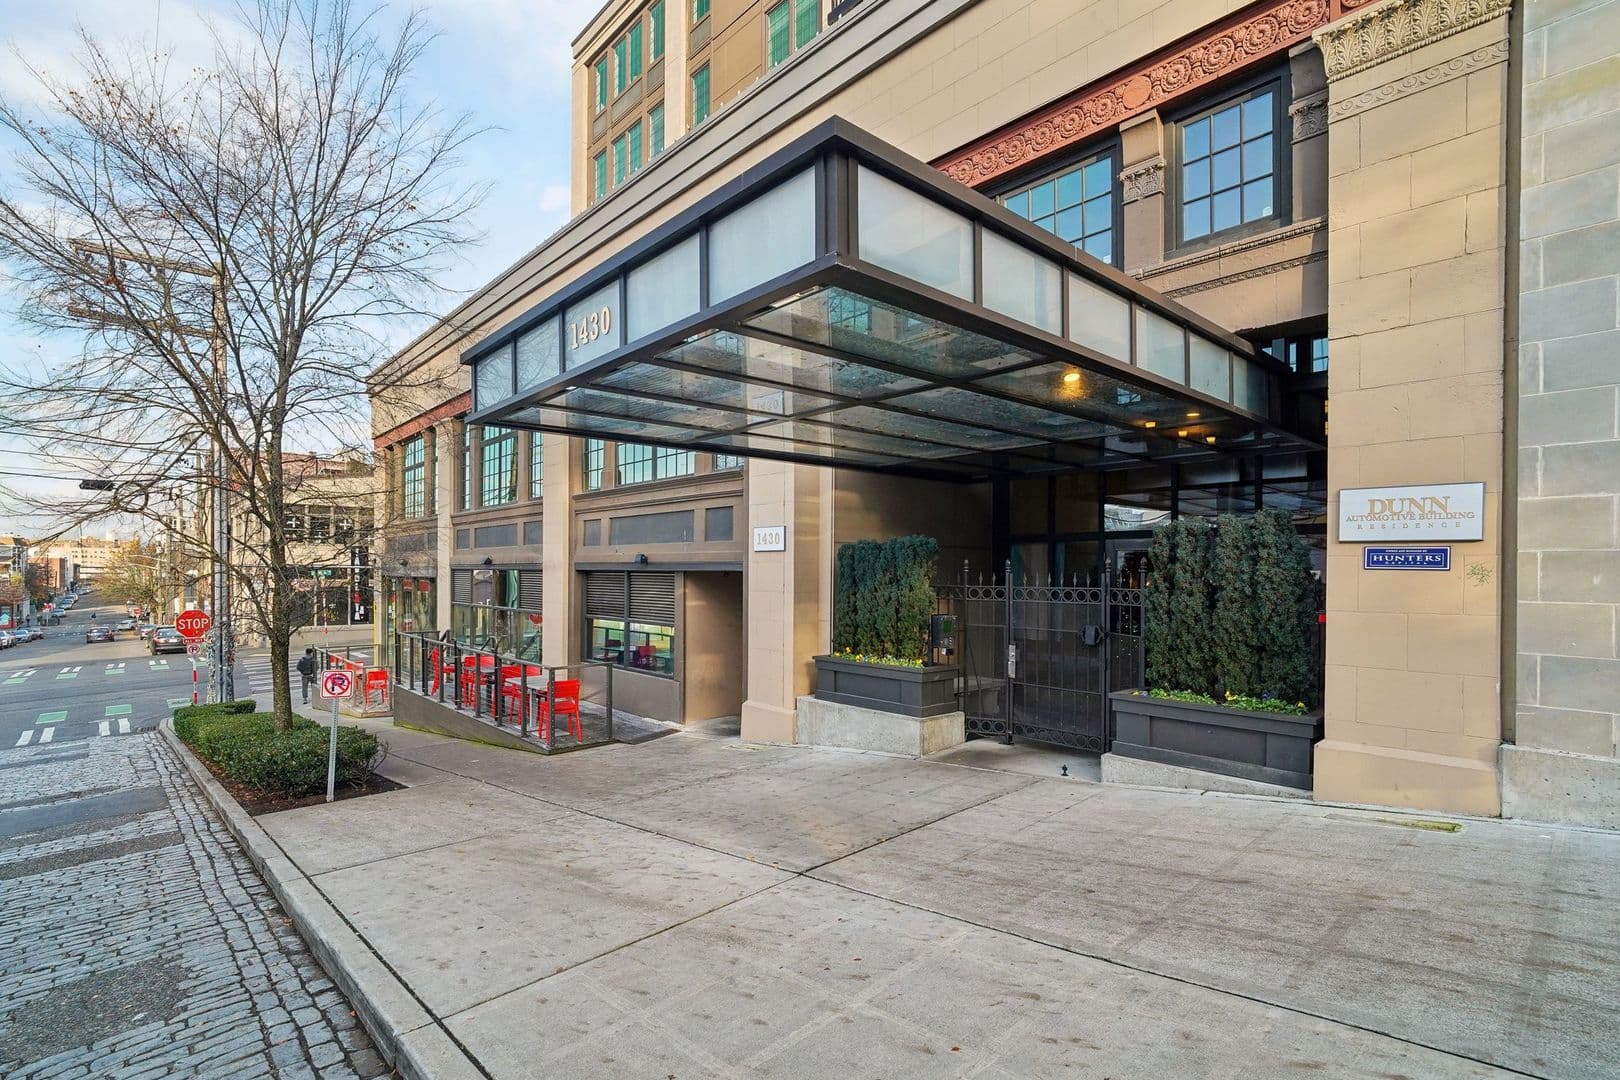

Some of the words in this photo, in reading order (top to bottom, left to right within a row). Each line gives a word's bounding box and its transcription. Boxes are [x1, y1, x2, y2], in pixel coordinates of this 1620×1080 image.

[571, 304, 611, 350] 1430
[1368, 496, 1450, 514] DUNN
[1346, 512, 1415, 522] AUTOMOTIVE
[1418, 512, 1475, 520] BUILDING
[1357, 521, 1462, 530] RESIDENCE
[756, 532, 781, 546] 1430
[178, 617, 209, 630] STOP
